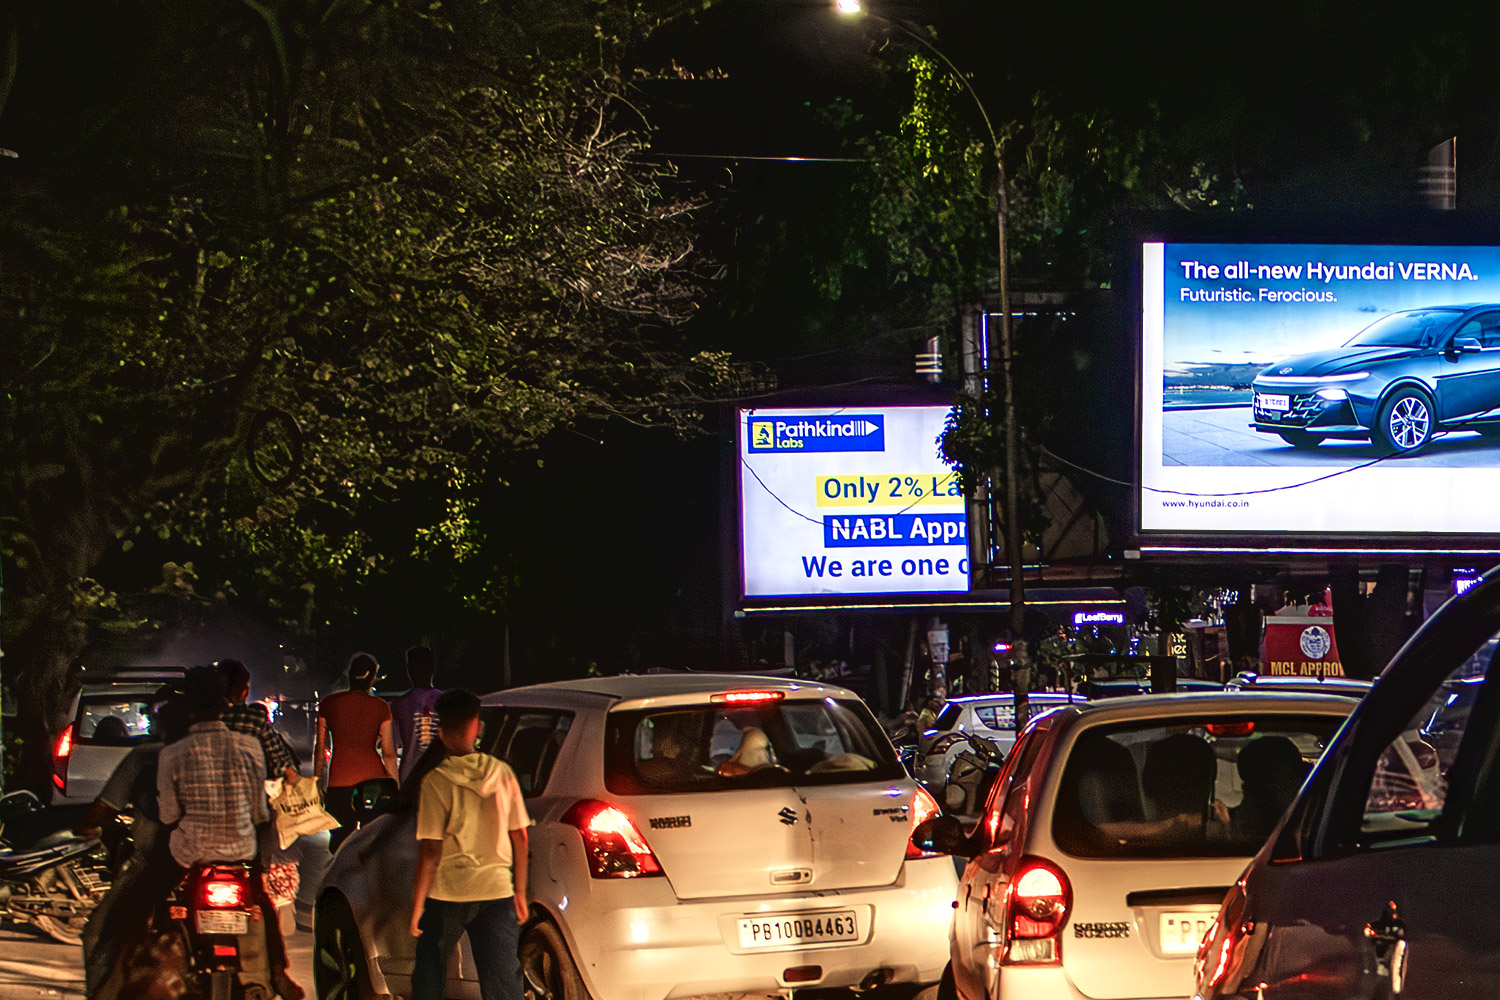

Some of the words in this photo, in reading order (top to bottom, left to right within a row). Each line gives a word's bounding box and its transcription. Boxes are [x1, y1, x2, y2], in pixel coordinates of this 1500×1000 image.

[1180, 260, 1220, 280] The
[1224, 260, 1302, 280] all-new
[1307, 261, 1395, 284] Hyundai
[1398, 262, 1479, 281] VERNA.
[1180, 287, 1256, 303] Futuristic.
[1259, 287, 1338, 303] Ferocious.
[776, 420, 855, 438] Pathkind
[776, 437, 804, 448] Labs
[824, 476, 880, 503] Only
[888, 477, 923, 498] 2%
[1162, 499, 1249, 509] www.hyundai.co.in
[832, 518, 902, 540] NABL
[801, 555, 843, 578] We
[851, 559, 893, 577] are
[901, 557, 950, 576] one
[1270, 661, 1297, 676] MCL
